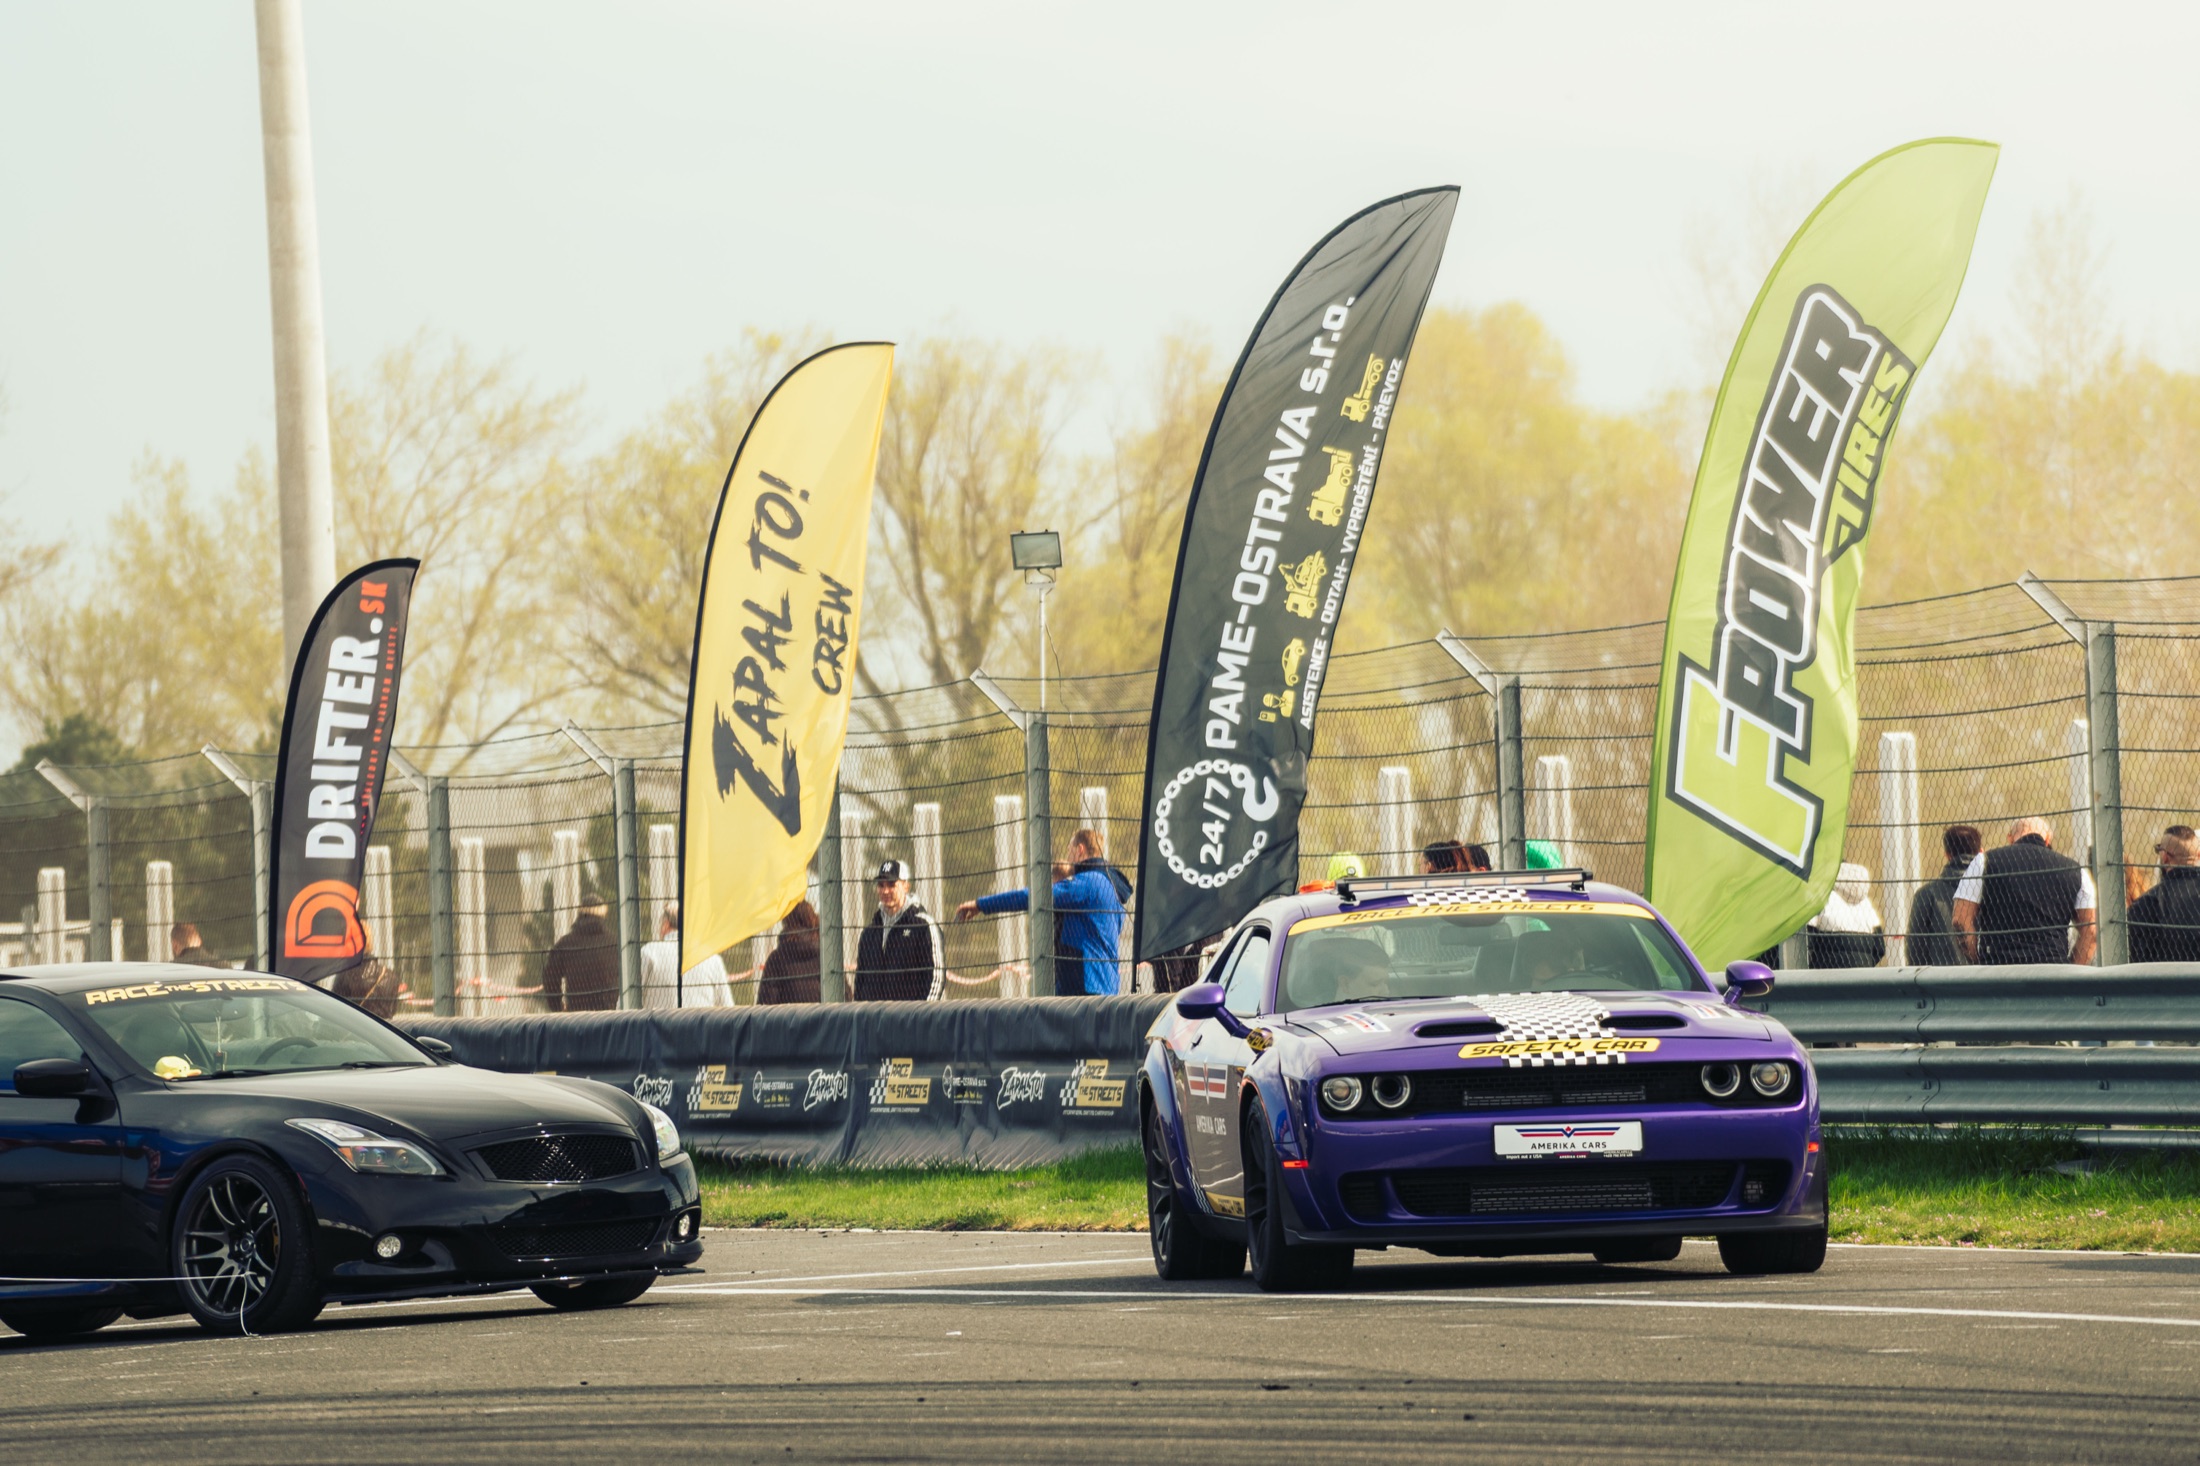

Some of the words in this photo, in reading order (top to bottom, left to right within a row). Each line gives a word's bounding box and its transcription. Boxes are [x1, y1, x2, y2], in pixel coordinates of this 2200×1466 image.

[1822, 351, 1911, 557] TIRES
[742, 470, 811, 575] TO!
[1205, 406, 1318, 749] PAME-OSTRAVA
[1299, 297, 1356, 394] s.r.o.
[1300, 637, 1327, 730] ASISTENCE
[1340, 444, 1378, 554] VYPROŠTĚNÍ
[1372, 358, 1402, 430] PŘEVOZ
[811, 570, 853, 696] CREW
[712, 589, 801, 838] ZAPAL
[1201, 777, 1230, 865] 24/7
[1343, 909, 1418, 923] RACE
[1421, 904, 1469, 914] THE
[1474, 902, 1595, 913] STREETS
[86, 983, 170, 1005] RACE
[165, 984, 193, 992] THE
[189, 980, 308, 993] STREETS
[1470, 1041, 1581, 1056] SAFETY
[1592, 1040, 1648, 1050] CAR
[705, 1071, 724, 1085] RACE
[891, 1063, 911, 1077] RACE
[1084, 1065, 1105, 1079] RACE
[710, 1090, 740, 1105] STREETS
[888, 1084, 896, 1093] THE
[896, 1084, 928, 1099] STREETS
[1088, 1086, 1123, 1102] STREETS
[1195, 1114, 1214, 1135] AMERIKA
[1214, 1116, 1227, 1136] CARS
[1530, 1141, 1576, 1150] AMERIKA
[1582, 1141, 1607, 1149] CARS
